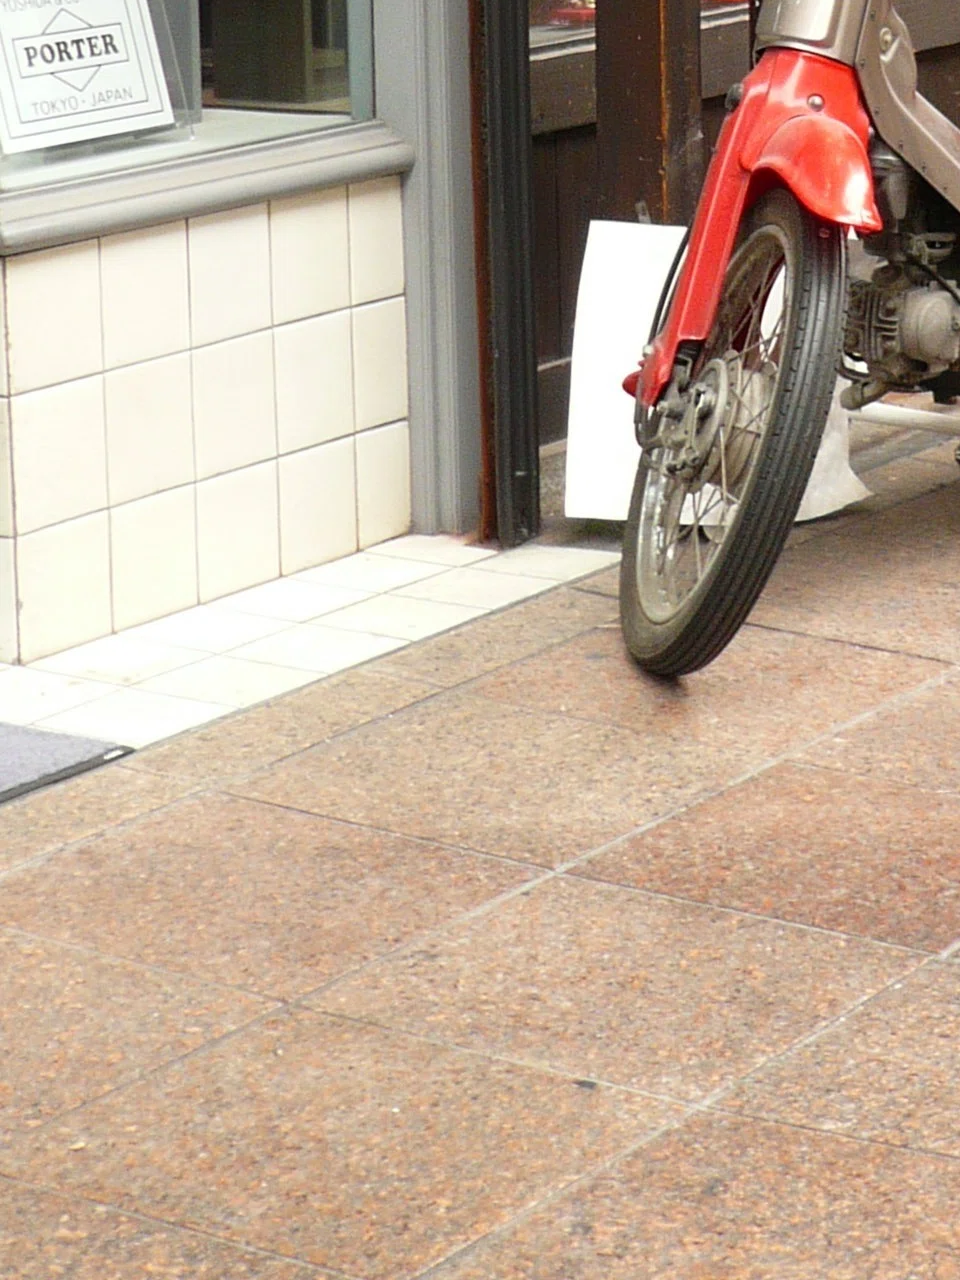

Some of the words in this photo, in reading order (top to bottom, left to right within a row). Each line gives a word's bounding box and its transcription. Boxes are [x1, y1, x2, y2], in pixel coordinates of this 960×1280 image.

[23, 33, 120, 68] PORTER
[32, 95, 80, 116] TOKYO
[91, 87, 134, 108] JAPAN
